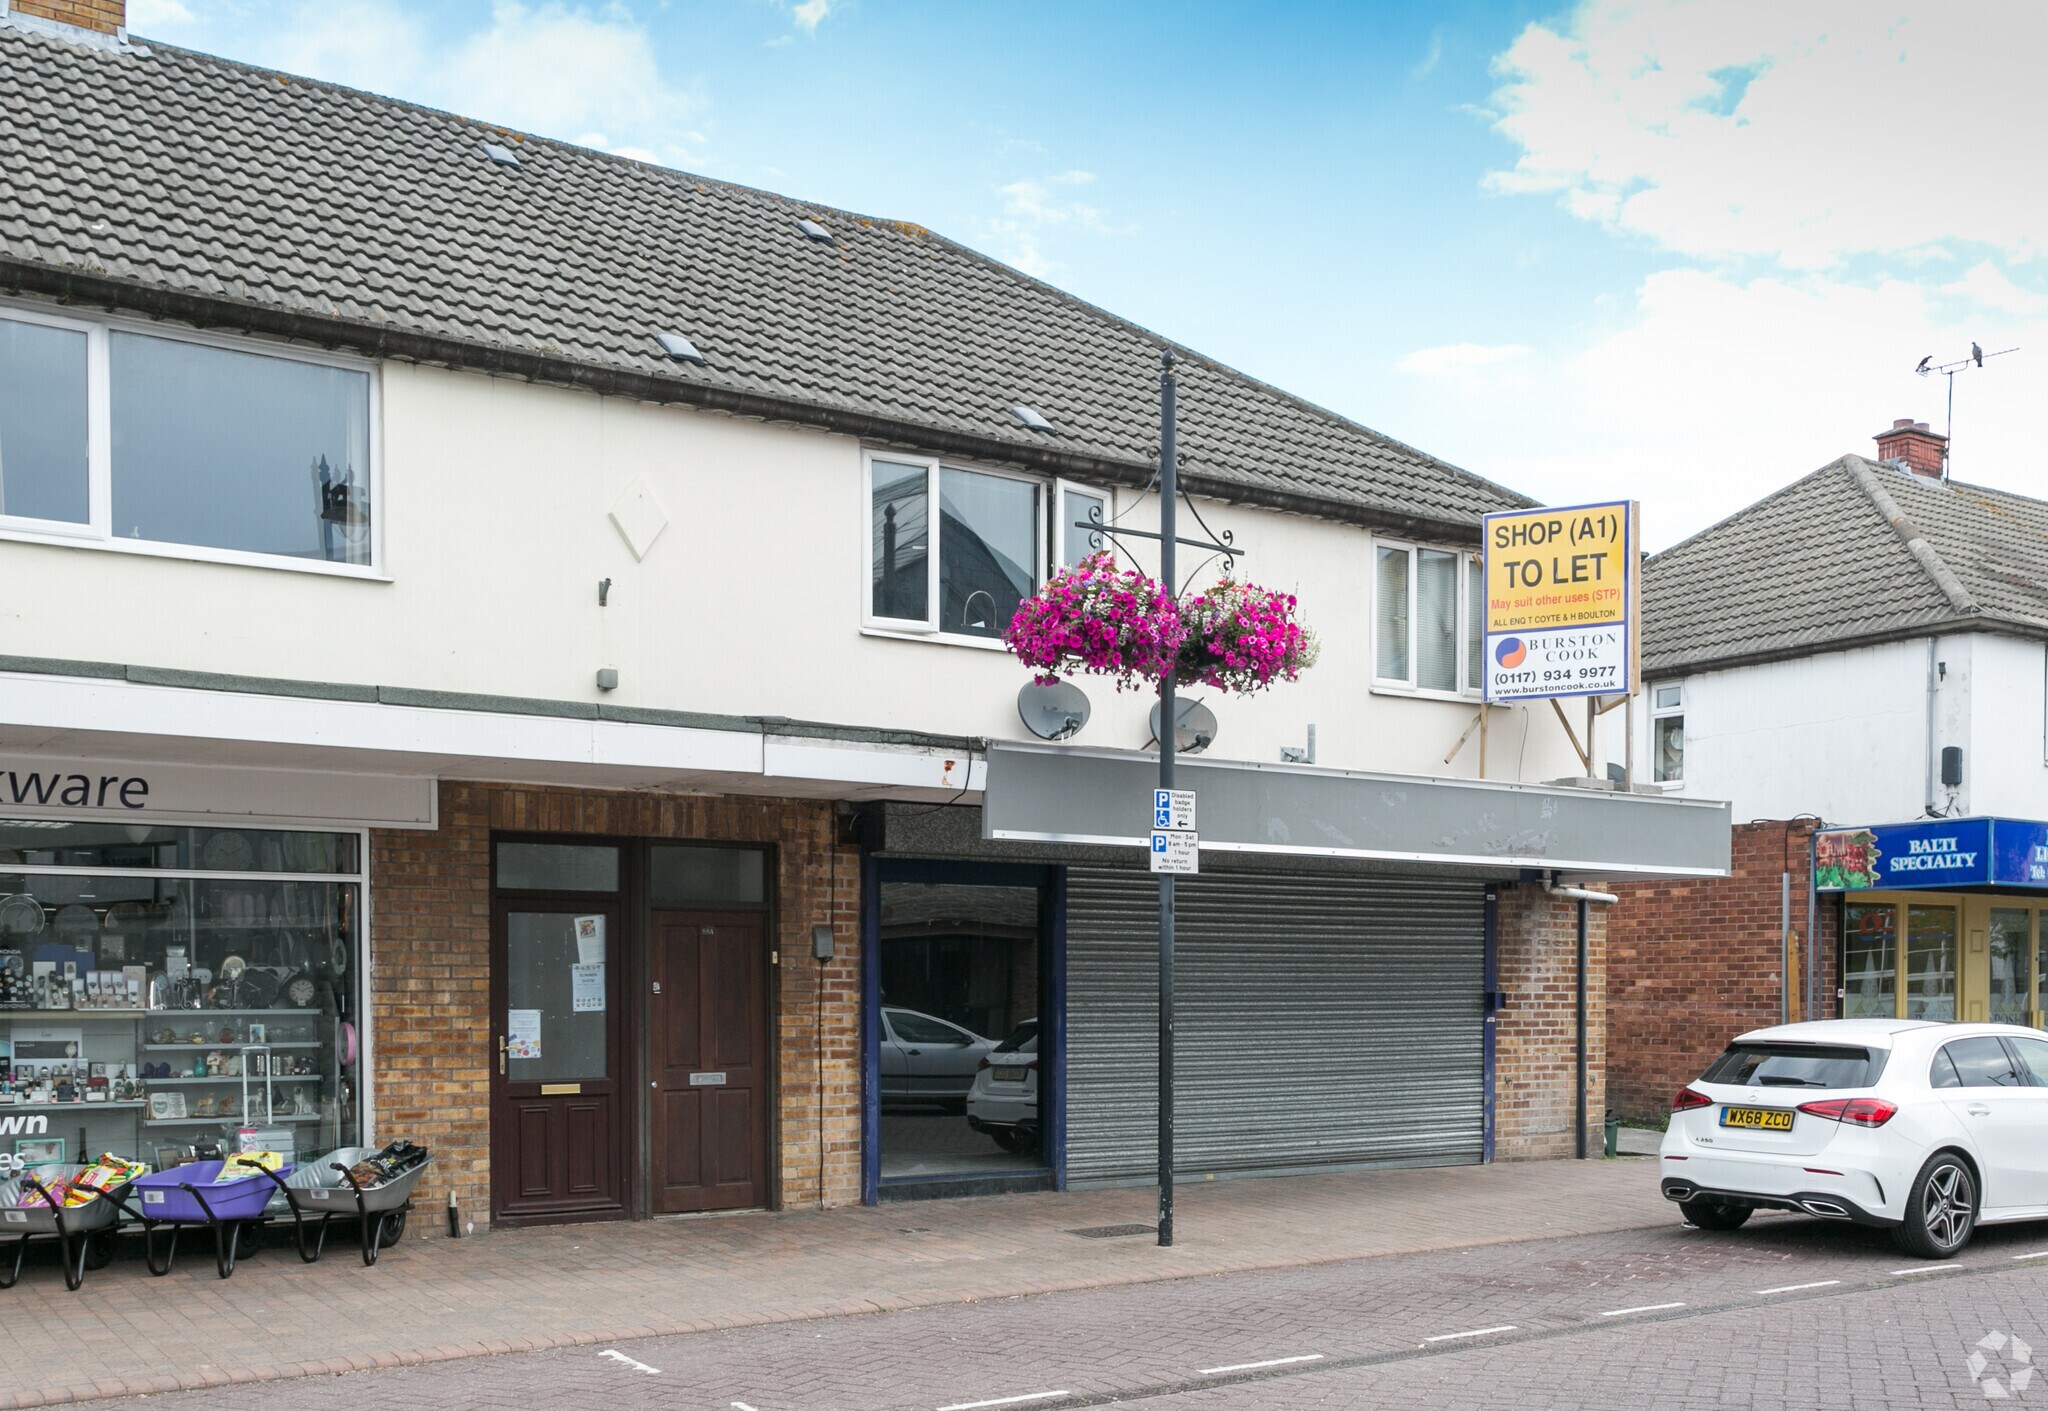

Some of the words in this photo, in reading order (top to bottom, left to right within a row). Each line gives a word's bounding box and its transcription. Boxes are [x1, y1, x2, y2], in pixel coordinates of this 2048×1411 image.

[1495, 520, 1563, 549] SHOP
[1570, 514, 1618, 547] (A1)
[1503, 559, 1543, 588] TO
[1553, 552, 1608, 585] LET
[1491, 599, 1511, 611] May
[1514, 596, 1533, 608] suit
[1535, 595, 1562, 606] other
[1565, 593, 1590, 604] uses
[1592, 588, 1621, 604] (STP)
[1493, 619, 1508, 627] ALL
[1510, 617, 1527, 626] ENQ
[1528, 616, 1533, 624] T
[1534, 614, 1561, 624] COYTE
[1562, 613, 1568, 622] &
[1570, 612, 1577, 621] H
[1578, 609, 1616, 620] BOULTON
[1529, 632, 1616, 650] BURSTON
[1545, 647, 1599, 662] COOK
[1495, 671, 1537, 686] (0117)
[1543, 669, 1572, 682] 934
[1579, 665, 1616, 679] 9977
[1495, 680, 1616, 695] www.burstoncook.co.uk
[0, 771, 149, 809] ware
[1909, 837, 1957, 854] BALTI
[1890, 852, 1977, 872] SPECIALTY
[1729, 1110, 1762, 1124] WX68
[1765, 1112, 1791, 1126] ZCO
